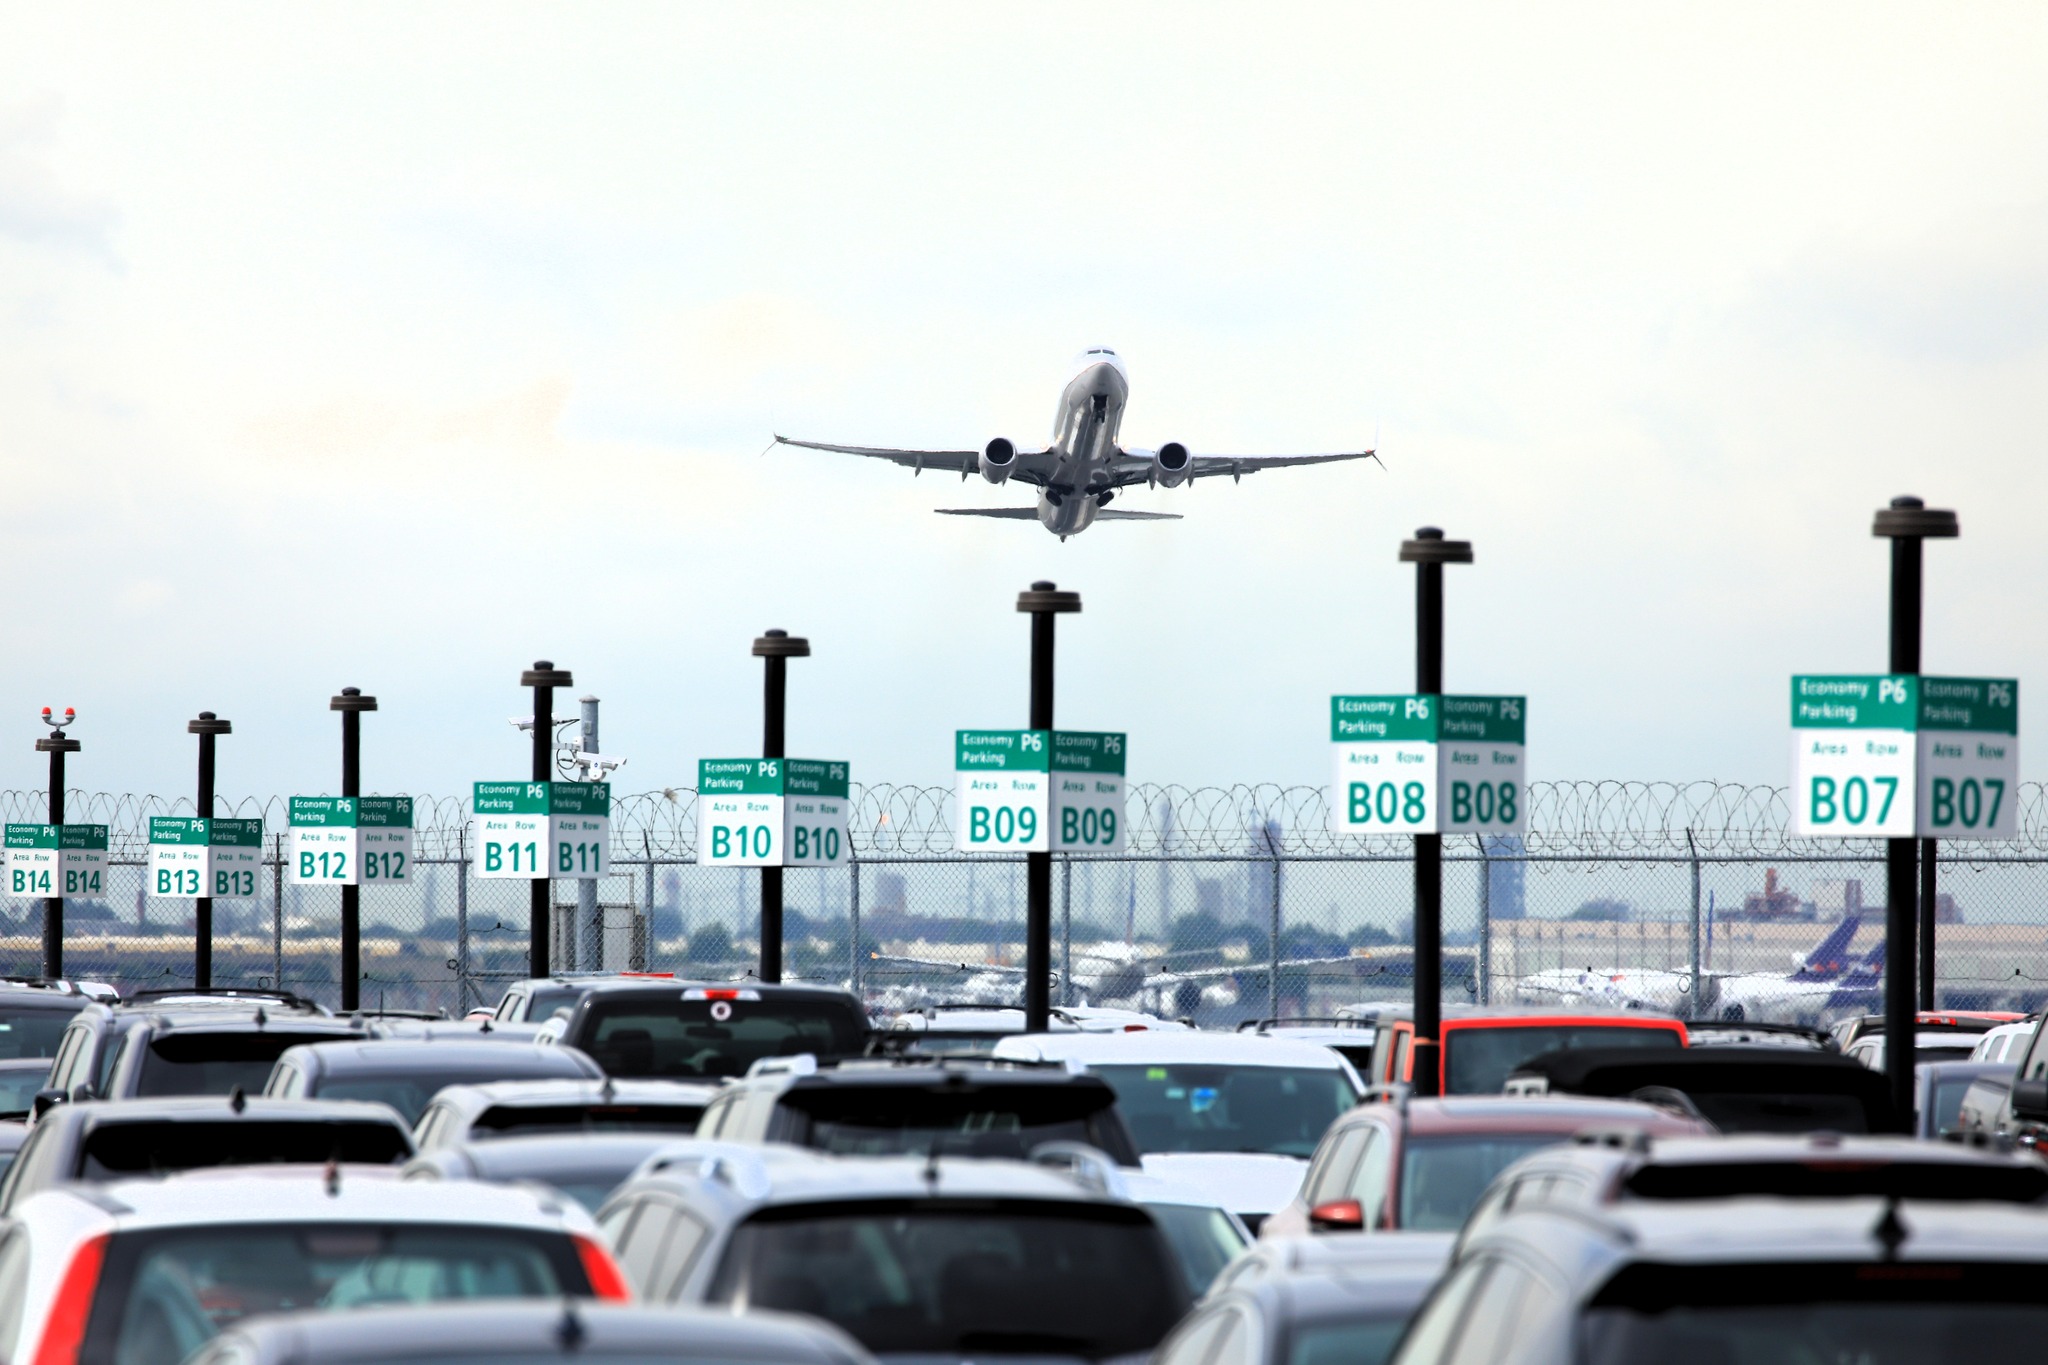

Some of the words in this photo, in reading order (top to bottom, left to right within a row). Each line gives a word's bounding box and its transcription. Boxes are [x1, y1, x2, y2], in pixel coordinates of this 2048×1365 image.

[1800, 679, 1868, 698] Economy
[1878, 678, 1906, 704] P6
[1924, 681, 1979, 701] Economy
[1988, 684, 2010, 707] P6
[1338, 699, 1396, 716] Economy
[1404, 698, 1429, 720] P6
[1444, 700, 1492, 716] Economy
[1500, 700, 1520, 720] P6
[1800, 702, 1857, 723] Parking
[1924, 704, 1970, 726] Parking
[1338, 720, 1386, 737] Parking
[1444, 720, 1485, 737] Parking
[962, 734, 1014, 748] Economy
[1020, 734, 1042, 752] P6
[1056, 735, 1097, 750] Economy
[1104, 736, 1121, 754] P6
[1812, 742, 1848, 754] Area
[1866, 740, 1898, 754] Row
[962, 751, 1006, 767] Parking
[1056, 752, 1091, 768] Parking
[1349, 752, 1378, 764] Area
[1396, 752, 1424, 764] Row
[705, 762, 752, 774] Economy
[758, 762, 778, 778] P6
[789, 762, 825, 775] Economy
[830, 764, 844, 780] P6
[478, 784, 520, 795] Economy
[527, 784, 544, 798] P6
[554, 785, 588, 796] Economy
[592, 786, 606, 800] P6
[705, 778, 744, 791] Parking
[789, 778, 820, 792] Parking
[971, 780, 998, 790] Area
[1012, 780, 1037, 790] Row
[294, 800, 332, 810] Economy
[336, 800, 352, 812] P6
[361, 800, 392, 810] Economy
[396, 800, 408, 812] P6
[478, 799, 514, 810] Parking
[554, 800, 582, 811] Parking
[713, 803, 737, 812] Area
[747, 802, 769, 811] Row
[1348, 782, 1425, 824] B08
[1451, 782, 1517, 824] B08
[1811, 776, 1898, 824] B07
[1932, 778, 2004, 828] B07
[154, 819, 186, 829] Economy
[191, 820, 204, 832] P6
[294, 812, 326, 823] Parking
[360, 812, 386, 823] Parking
[970, 806, 1036, 842] B09
[1062, 806, 1116, 845] B09
[8, 826, 38, 834] Economy
[43, 826, 55, 837] P6
[63, 827, 89, 835] Economy
[94, 827, 104, 838] P6
[212, 822, 242, 830] Economy
[246, 822, 258, 833] P6
[486, 822, 507, 830] Area
[515, 822, 536, 830] Row
[9, 836, 34, 846] Parking
[63, 838, 85, 846] Parking
[154, 831, 181, 841] Parking
[212, 833, 238, 842] Parking
[301, 833, 320, 841] Area
[712, 826, 771, 858] B10
[794, 826, 839, 860] B10
[159, 852, 176, 860] Area
[183, 852, 199, 860] Row
[486, 842, 536, 872] B11
[558, 842, 600, 872] B11
[300, 852, 346, 878] B12
[366, 852, 404, 878] B12
[13, 870, 51, 892] B14
[66, 870, 100, 893] B14
[158, 869, 199, 894] B13
[216, 870, 254, 896] B13
